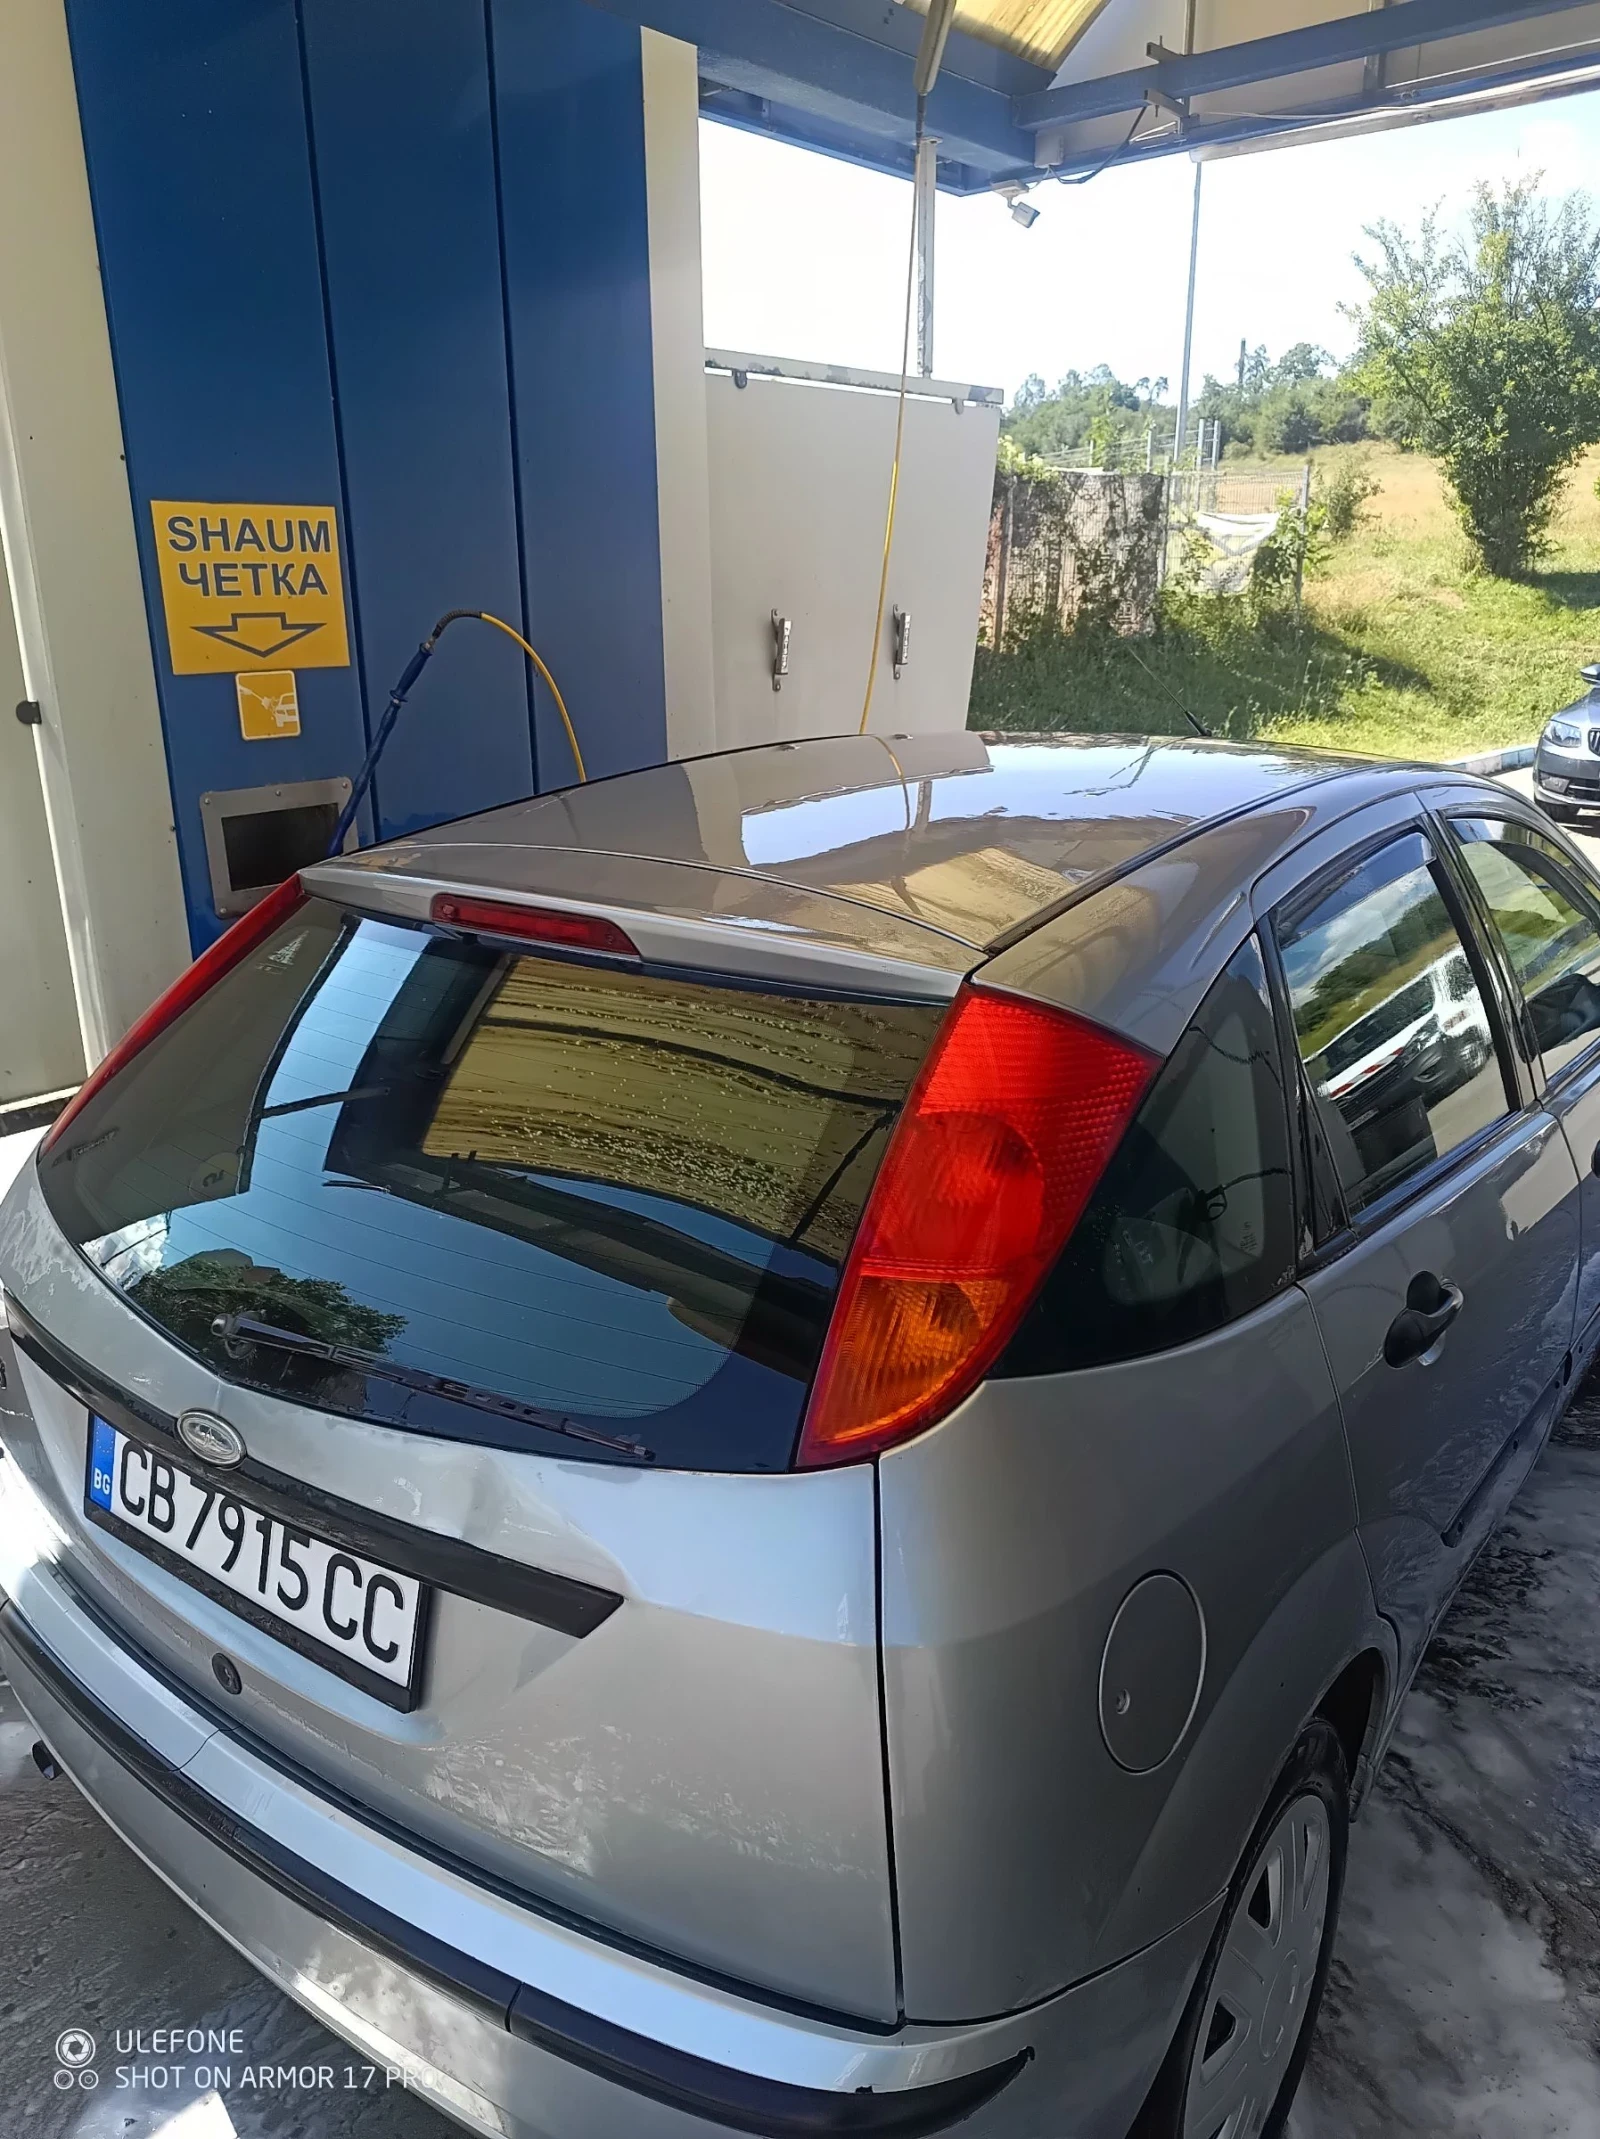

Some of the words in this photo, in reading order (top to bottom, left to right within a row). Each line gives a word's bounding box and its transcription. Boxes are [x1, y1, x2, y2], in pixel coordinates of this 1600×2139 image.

[167, 516, 331, 553] SHAUM
[178, 562, 329, 597] ЧЕТКА
[93, 1466, 111, 1496] BG
[185, 1475, 312, 1612] 7915
